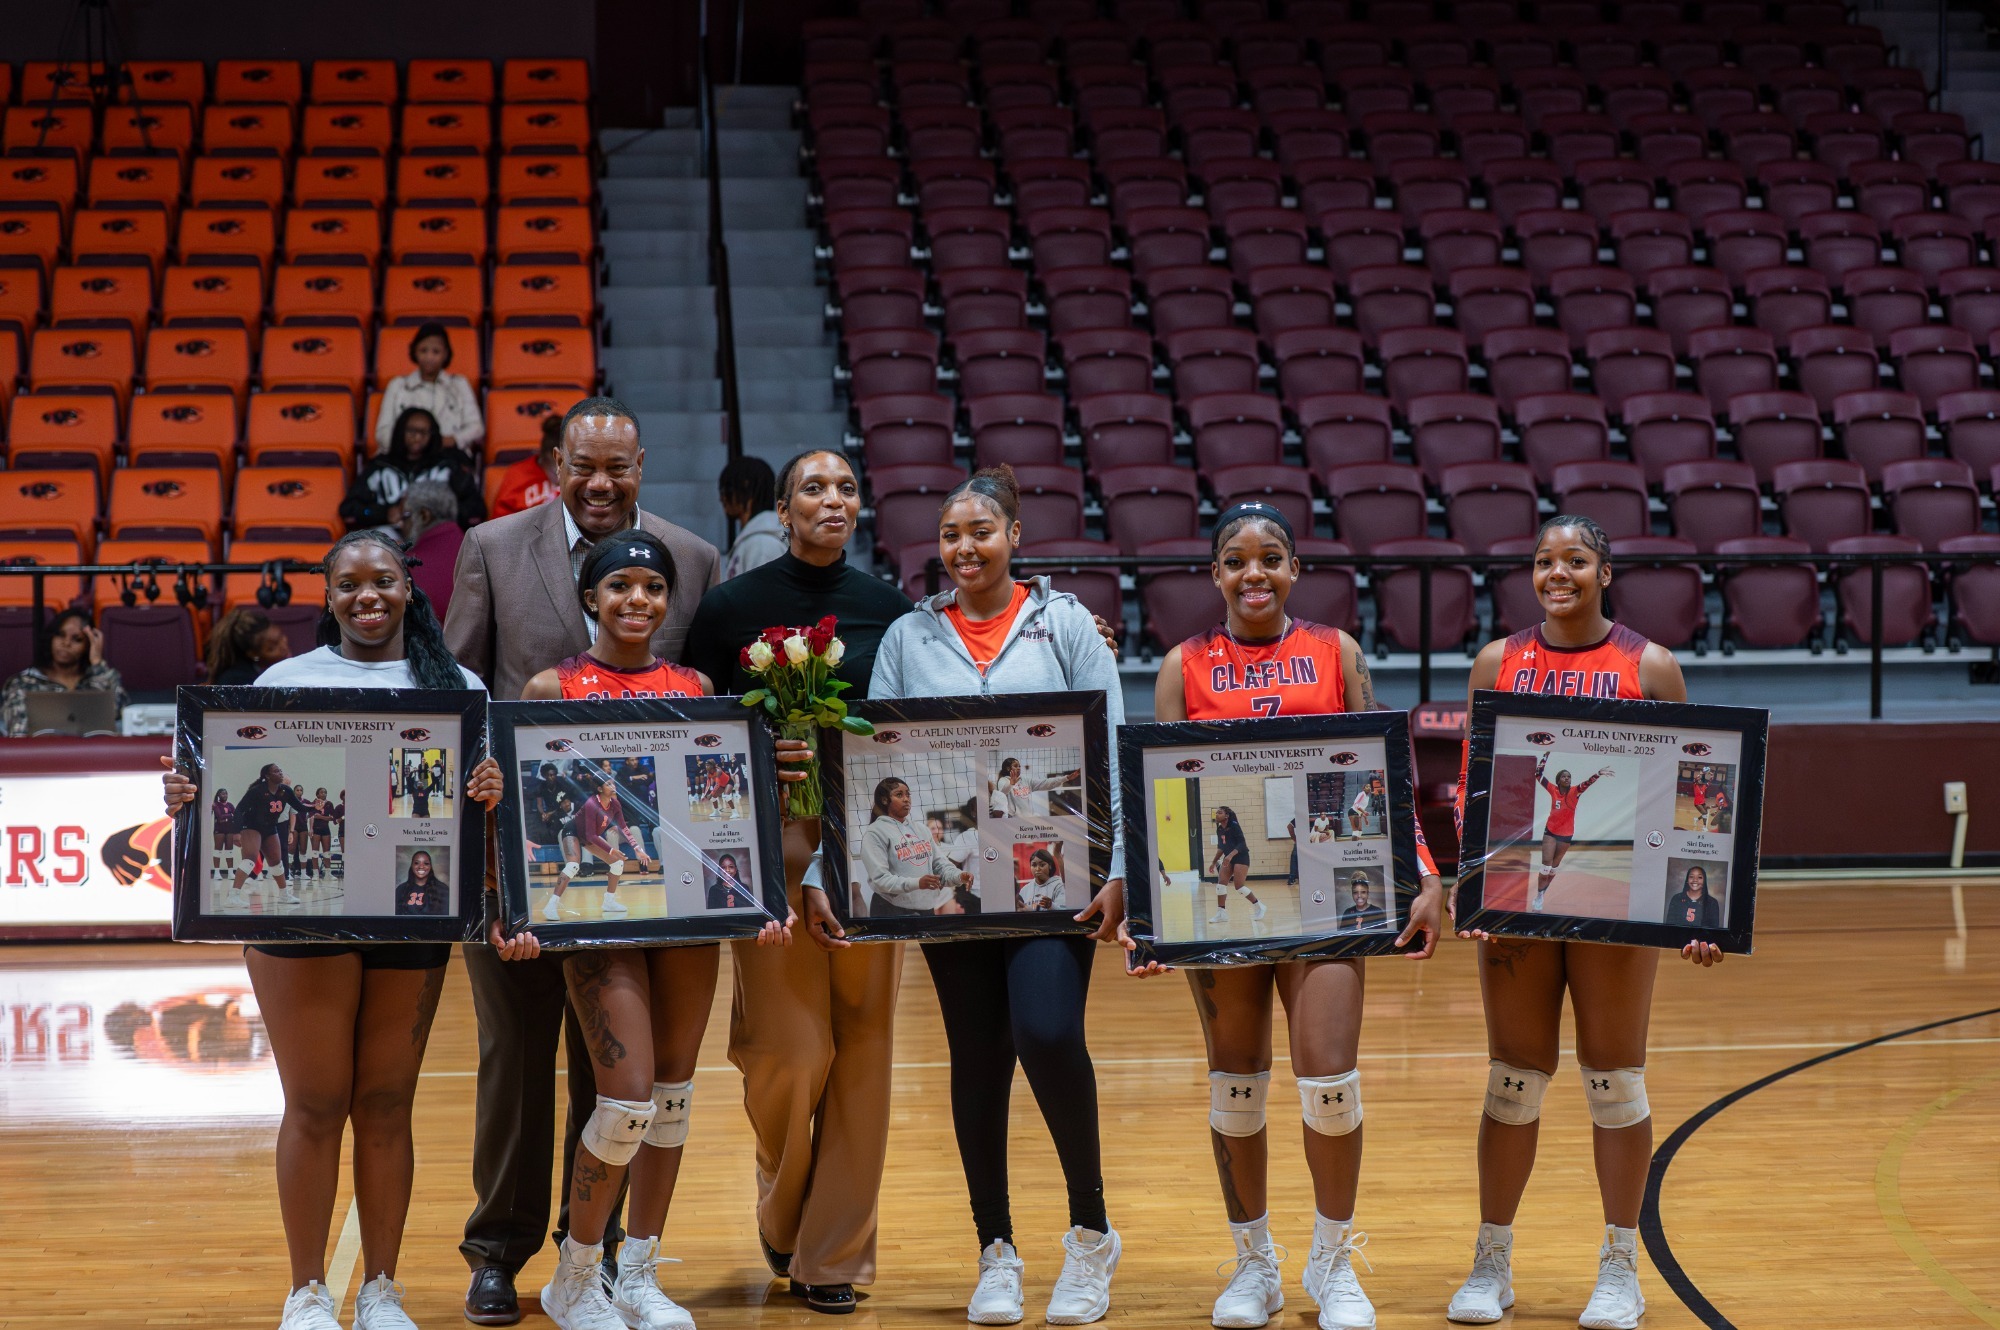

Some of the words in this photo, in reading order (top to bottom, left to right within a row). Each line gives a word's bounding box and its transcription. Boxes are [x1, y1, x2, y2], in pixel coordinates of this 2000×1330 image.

[1212, 656, 1318, 693] CLAFLIN
[274, 720, 324, 730] CLAFLIN
[326, 721, 396, 731] UNIVERSITY
[910, 728, 954, 738] CLAFLIN
[957, 725, 1018, 736] UNIVERSITY
[296, 733, 342, 745] Volleyball
[350, 734, 373, 744] 2025
[579, 731, 625, 741] CLAFLIN
[627, 729, 689, 740] UNIVERSITY
[1561, 728, 1609, 740] CLAFLIN
[1612, 732, 1678, 745] UNIVERSITY
[600, 743, 642, 755] Volleyball
[650, 742, 670, 752] 2025
[929, 739, 971, 750] Volleyball
[979, 738, 1000, 748] 2025
[1583, 742, 1625, 754] Volleyball
[1634, 746, 1655, 755] 2025
[1210, 752, 1258, 762] CLAFLIN
[1260, 747, 1325, 760] UNIVERSITY
[1232, 763, 1275, 774] Volleyball
[1283, 761, 1304, 771] 2025
[269, 800, 283, 813] 33
[1555, 800, 1561, 810] 5
[0, 825, 90, 887] RS
[726, 894, 735, 908] 2
[1685, 907, 1696, 922] 5
